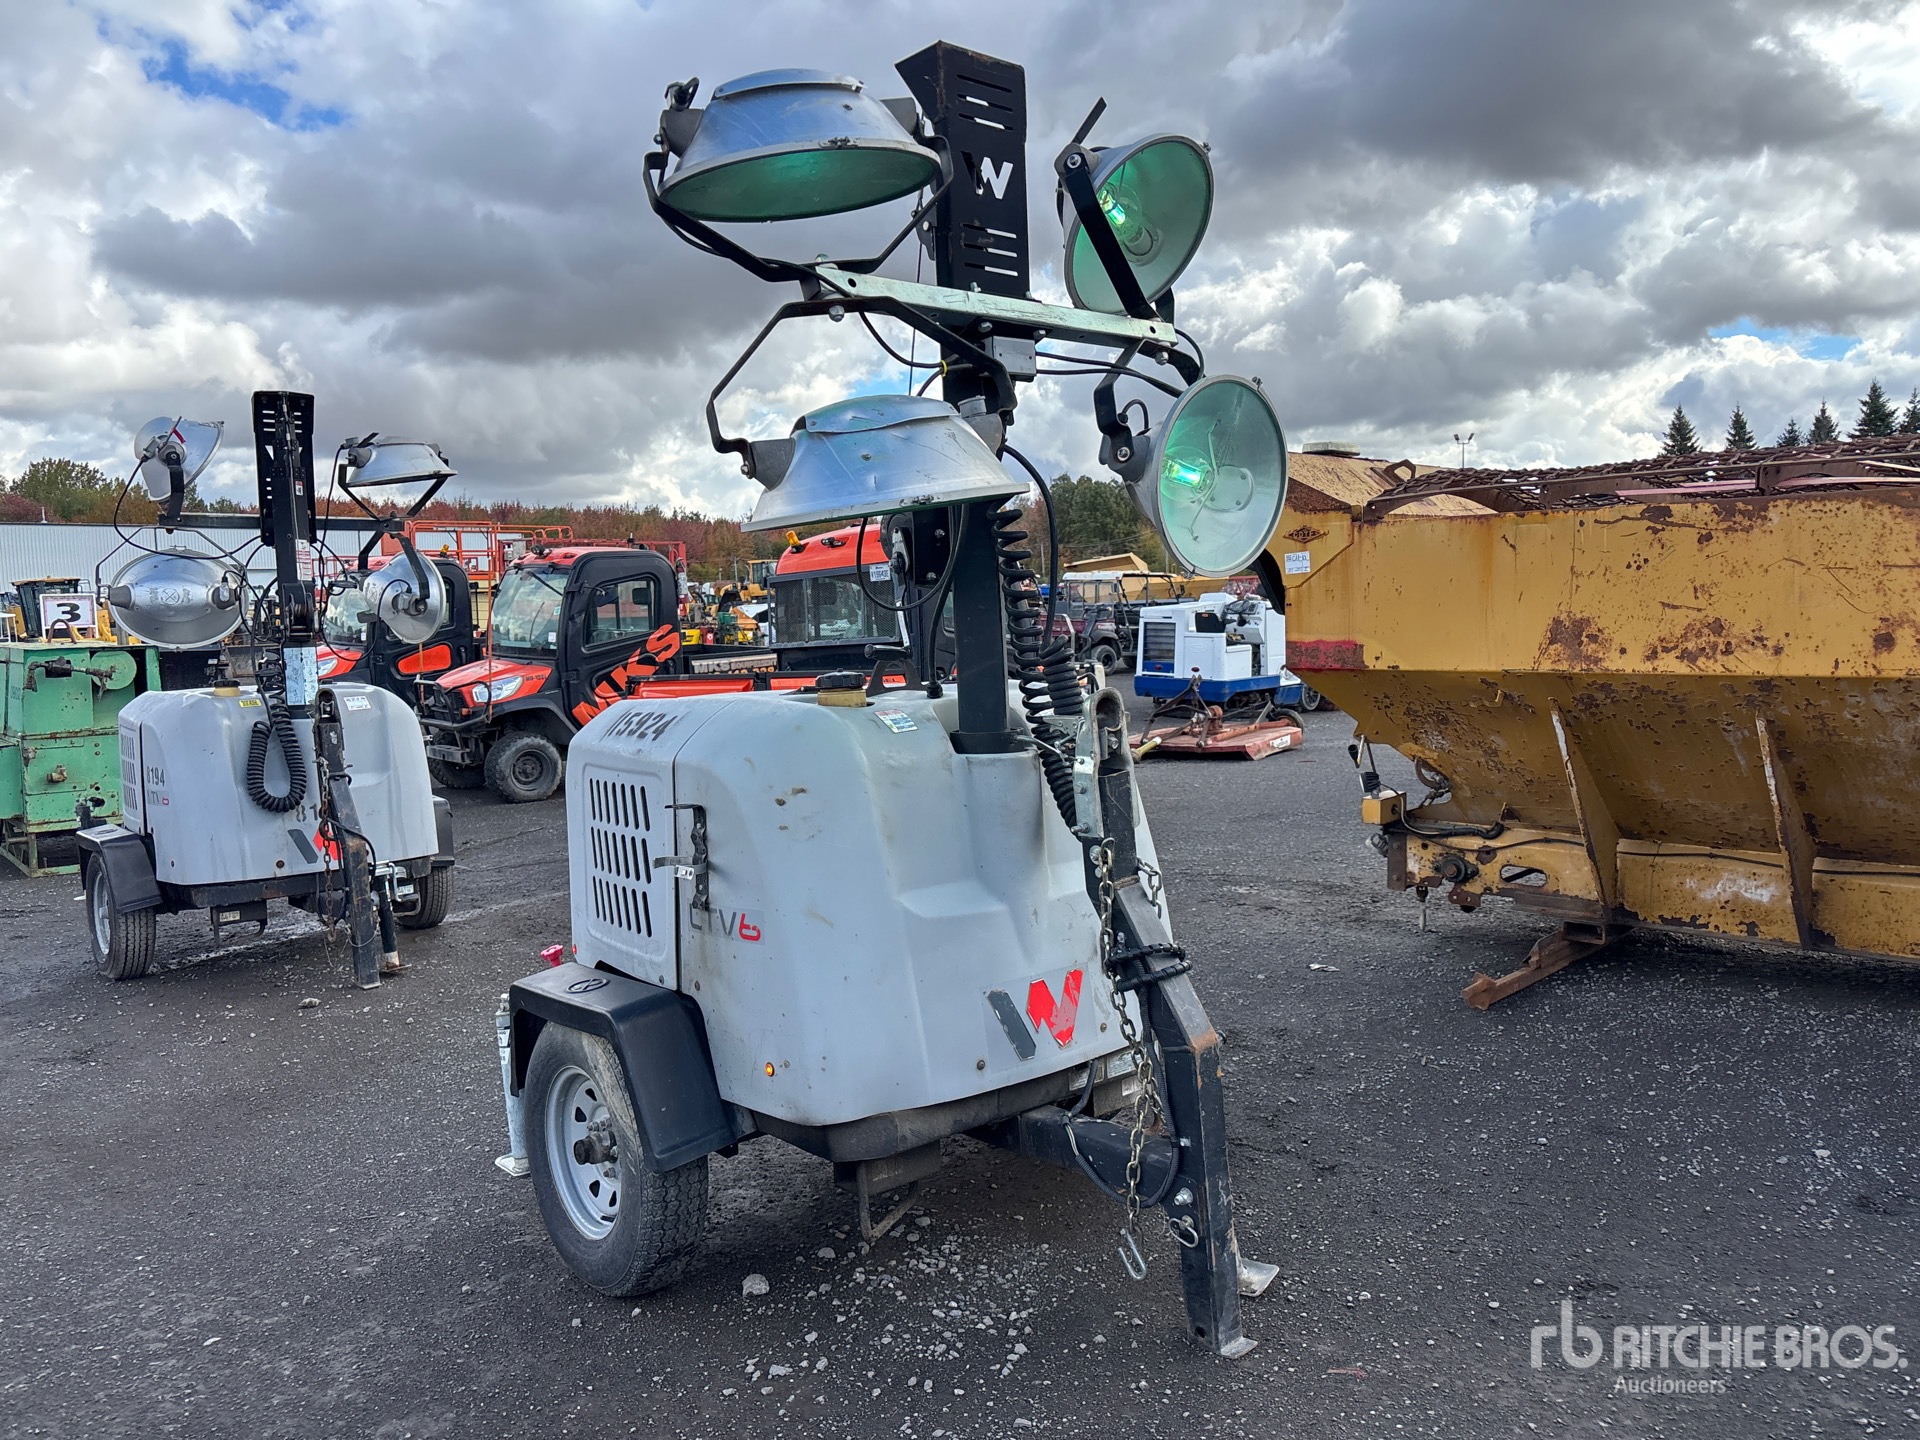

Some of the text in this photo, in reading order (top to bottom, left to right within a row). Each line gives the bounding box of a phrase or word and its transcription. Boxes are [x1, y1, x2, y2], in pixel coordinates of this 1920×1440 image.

[56, 602, 82, 623] 3
[572, 623, 680, 726] MKS
[694, 659, 730, 674] MKS
[146, 765, 165, 787] 8194
